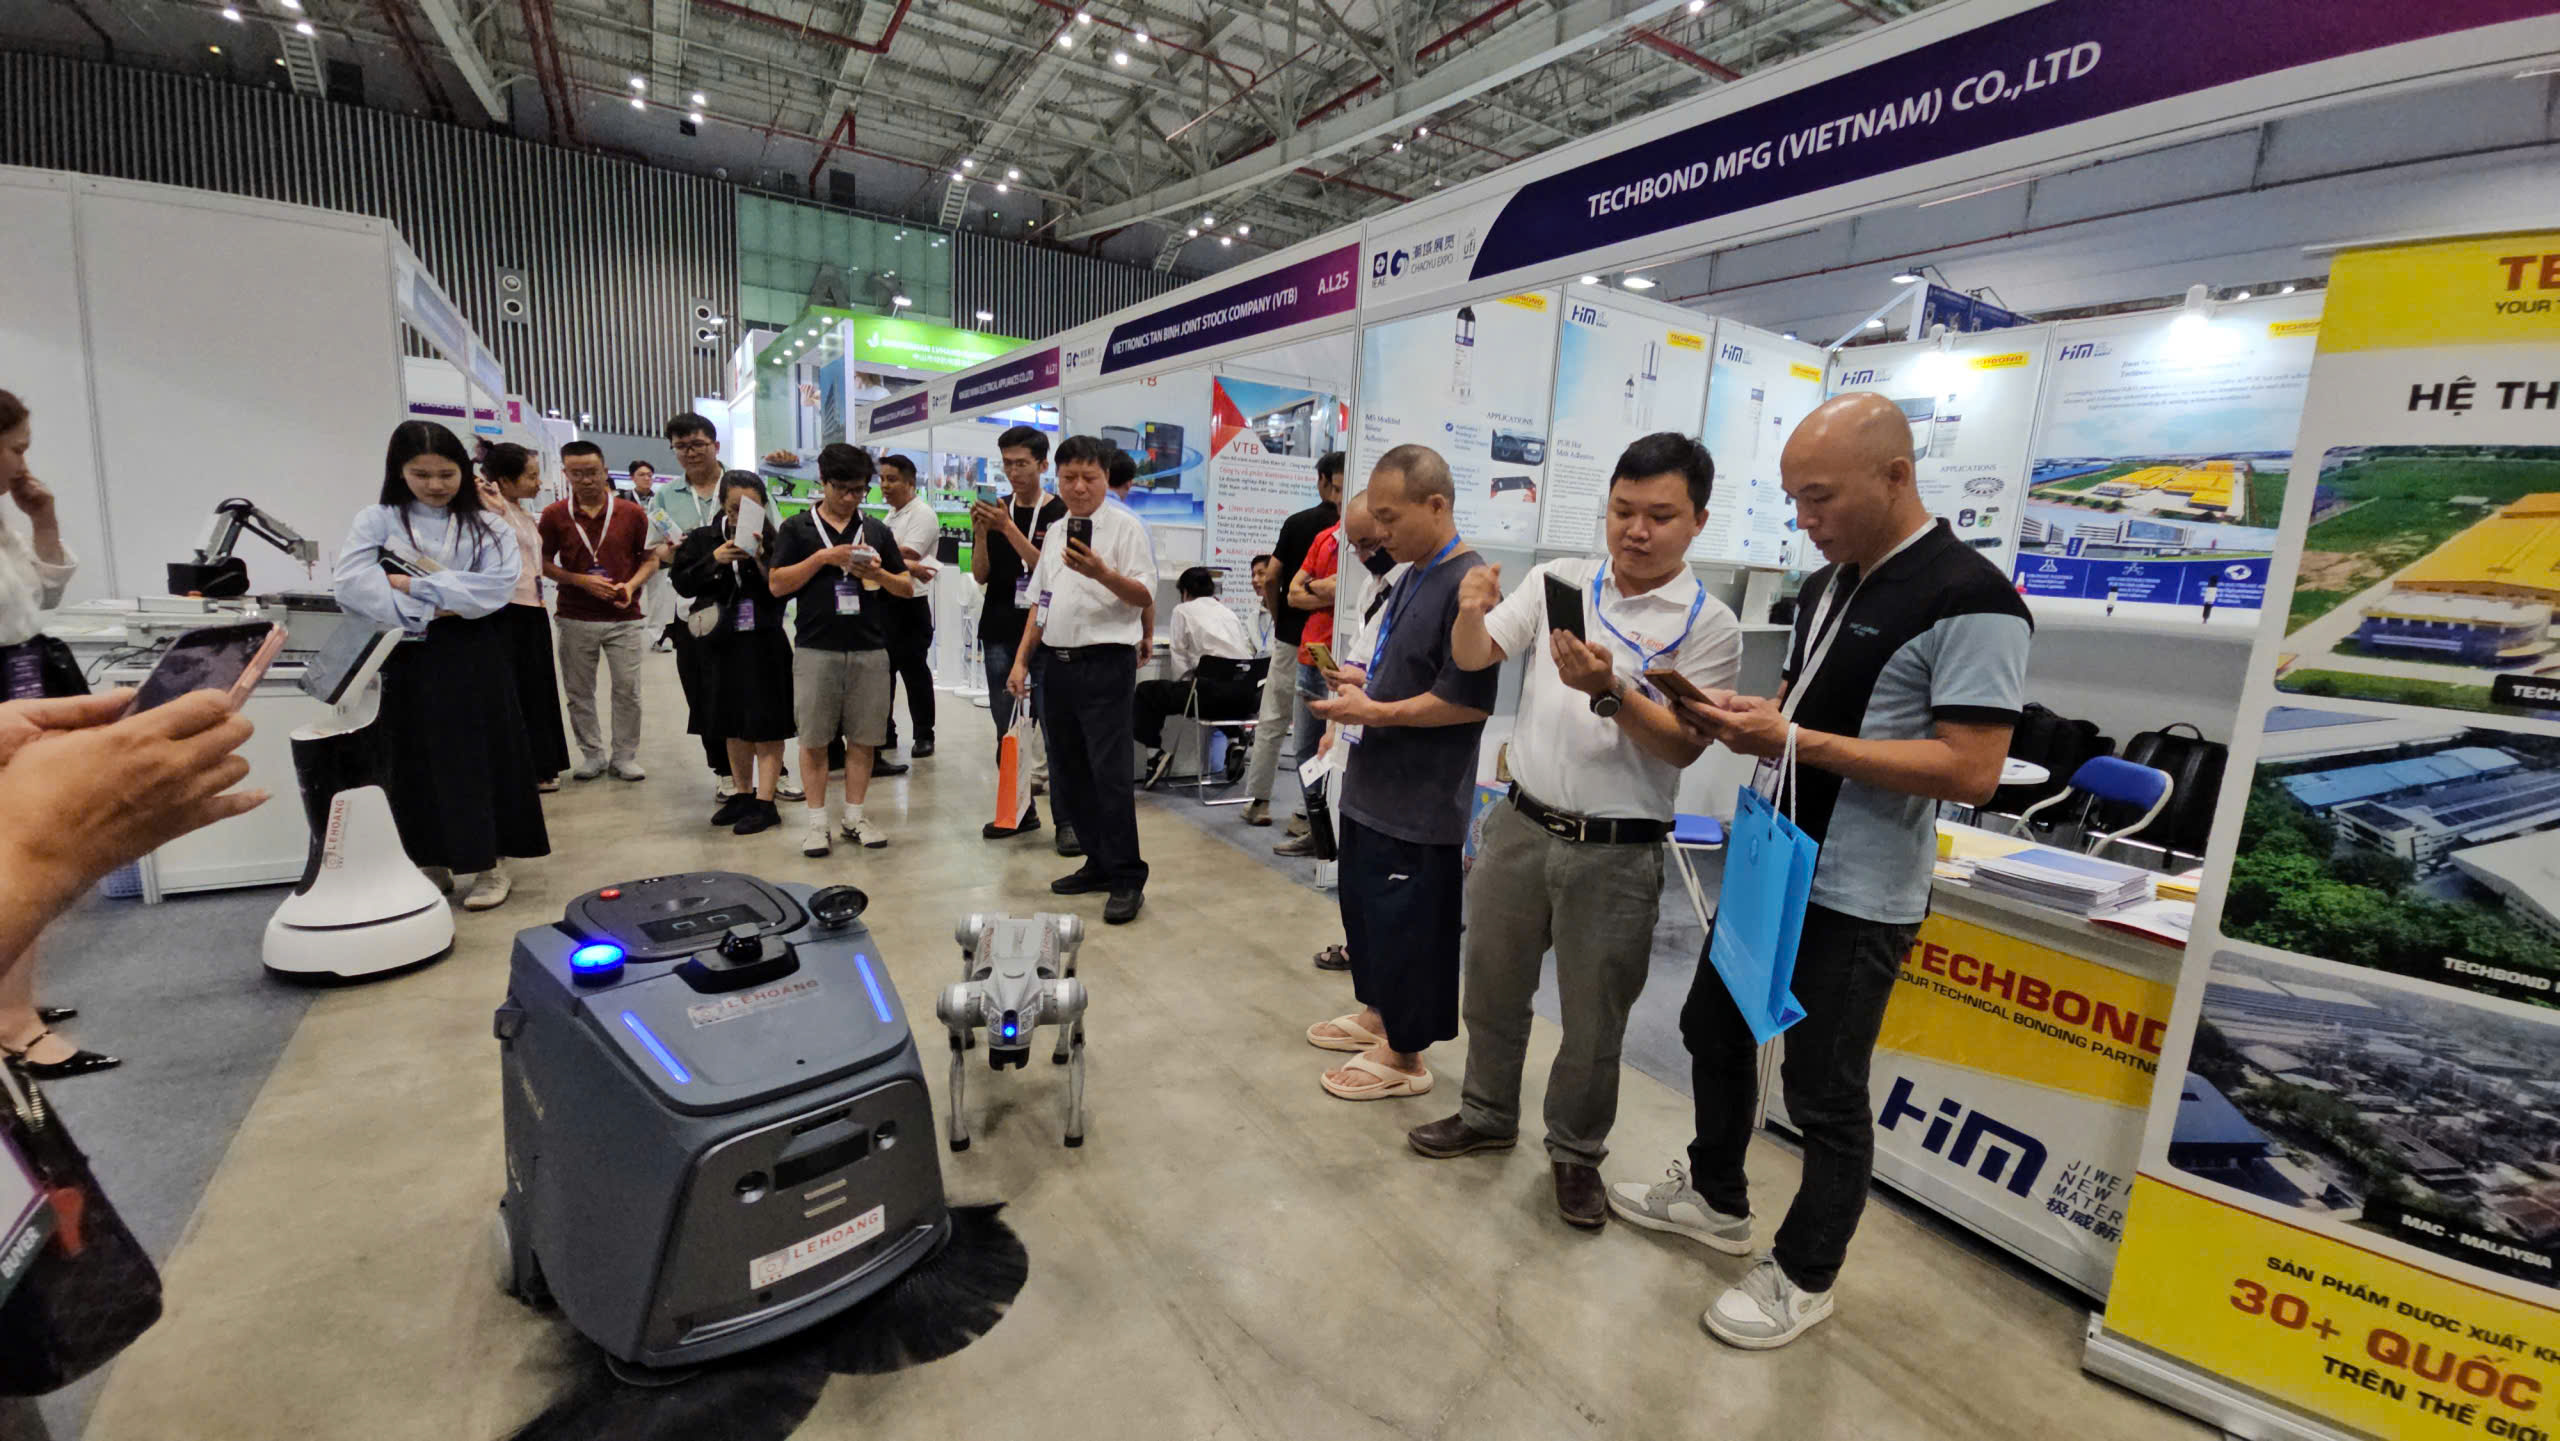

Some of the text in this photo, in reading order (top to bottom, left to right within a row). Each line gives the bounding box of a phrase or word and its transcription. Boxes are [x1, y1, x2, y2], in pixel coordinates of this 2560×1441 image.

[1588, 41, 2102, 218] TECHBOND MFG (VIETNAM) CO.,LTD
[1112, 286, 1298, 355] VIETTRONICS TAN BINH JOINT STOCK COMPANY (VTB)
[2496, 300, 2551, 314] YOUR
[1487, 412, 1535, 426] APPLICATIONS
[2408, 375, 2476, 416] HỆ
[1233, 441, 1259, 456] VTB
[328, 800, 345, 850] LEHOANG
[727, 979, 819, 1008] LEHOANG
[2444, 956, 2551, 990] TECHBOND
[1899, 970, 1929, 988] OUR
[1931, 981, 2009, 1020] TECHNICAL
[2013, 1011, 2087, 1049] BONDING
[2052, 1183, 2123, 1225] MATER
[2060, 1170, 2112, 1202] NEW
[0, 1227, 40, 1279] BUYER
[794, 1212, 879, 1259] LEHOANG
[2402, 1214, 2446, 1237] MAC
[2459, 1233, 2552, 1269] MALAYSIA
[2230, 1278, 2543, 1412] 30+ QUỐC
[2323, 1355, 2406, 1402] TRÊN
